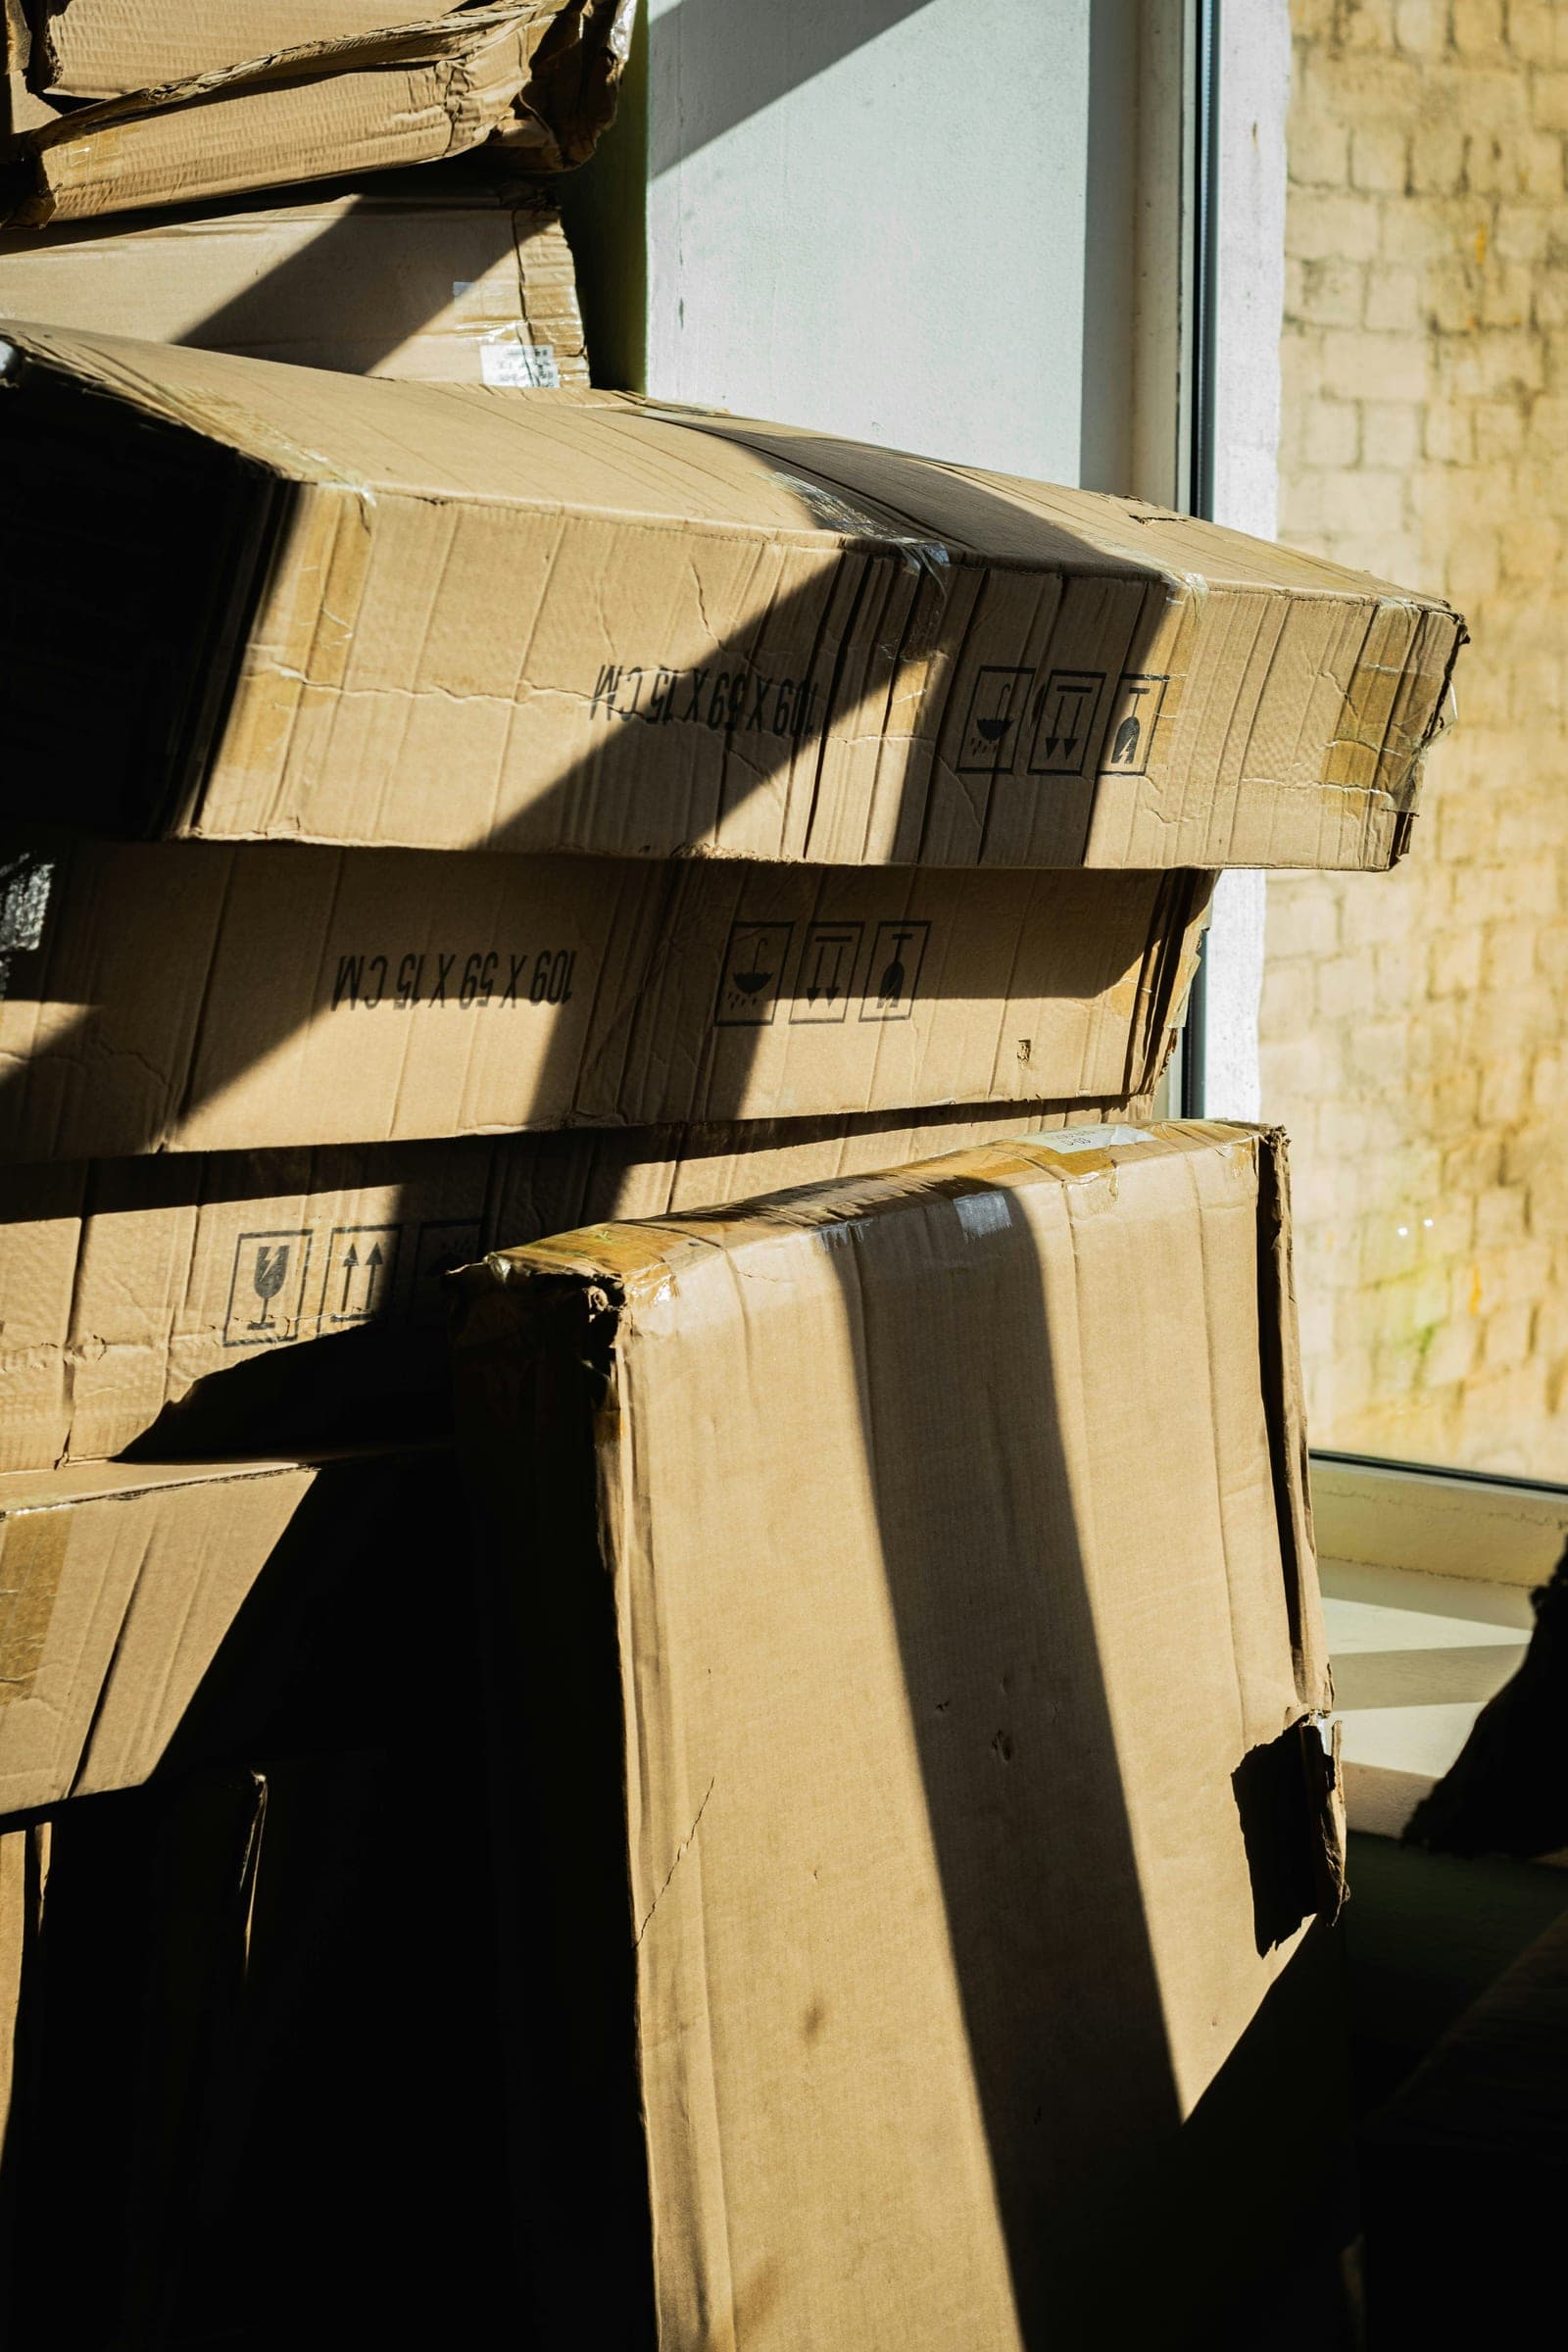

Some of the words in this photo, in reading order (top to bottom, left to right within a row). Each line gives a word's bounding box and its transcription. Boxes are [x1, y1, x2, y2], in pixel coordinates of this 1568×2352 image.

[646, 666, 678, 725] 15
[682, 667, 710, 723] X
[747, 676, 772, 734] X
[330, 955, 388, 1011] CM
[393, 953, 424, 1010] 15
[428, 953, 457, 1009] X
[460, 952, 499, 1010] 59
[500, 955, 527, 1008] X
[529, 949, 577, 1006] 109
